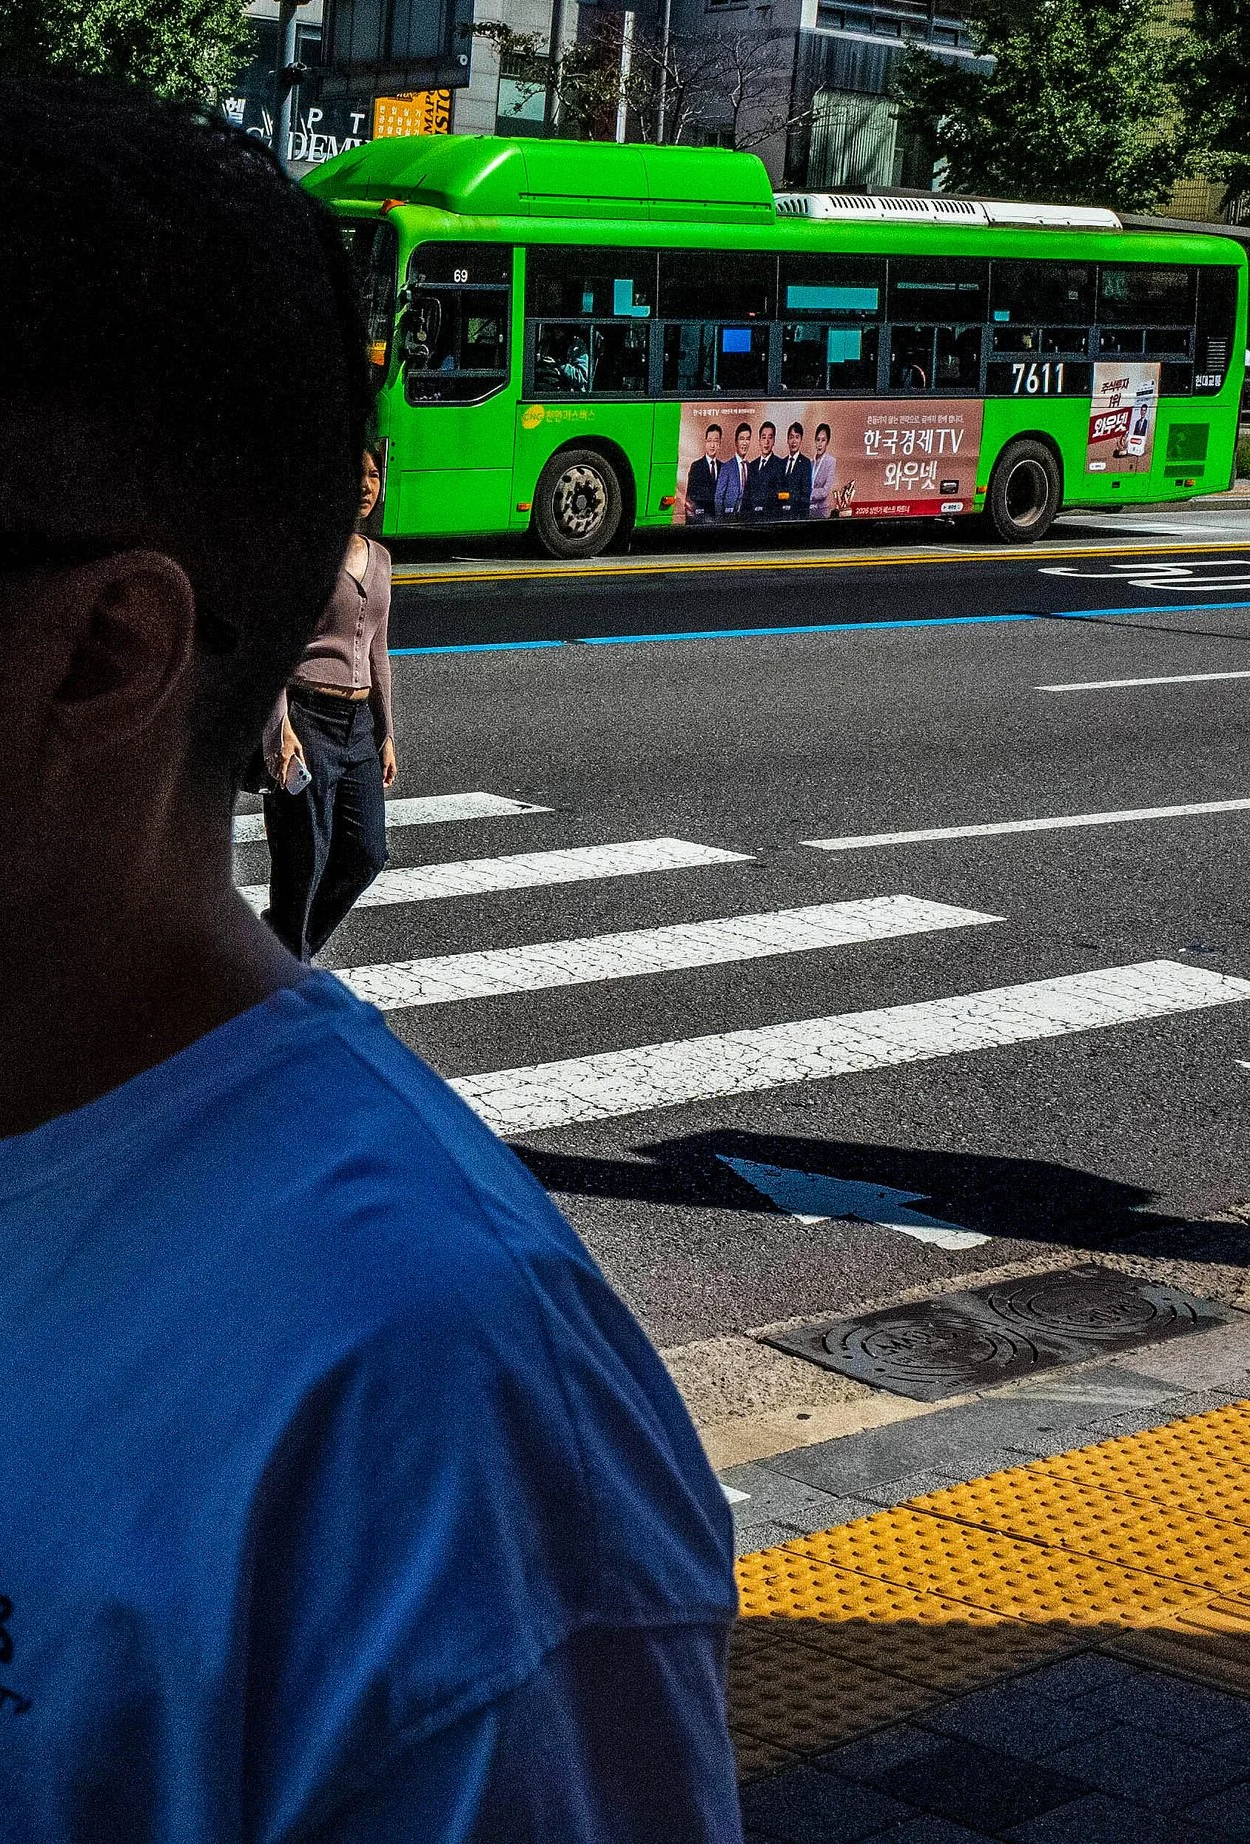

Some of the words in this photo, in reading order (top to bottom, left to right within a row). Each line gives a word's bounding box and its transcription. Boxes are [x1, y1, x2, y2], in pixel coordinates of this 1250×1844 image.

[454, 269, 468, 283] 69
[1012, 363, 1064, 394] 7611
[1091, 411, 1129, 438] 와우넷
[864, 429, 964, 456] 한국경제TV
[883, 460, 938, 491] 와우넷
